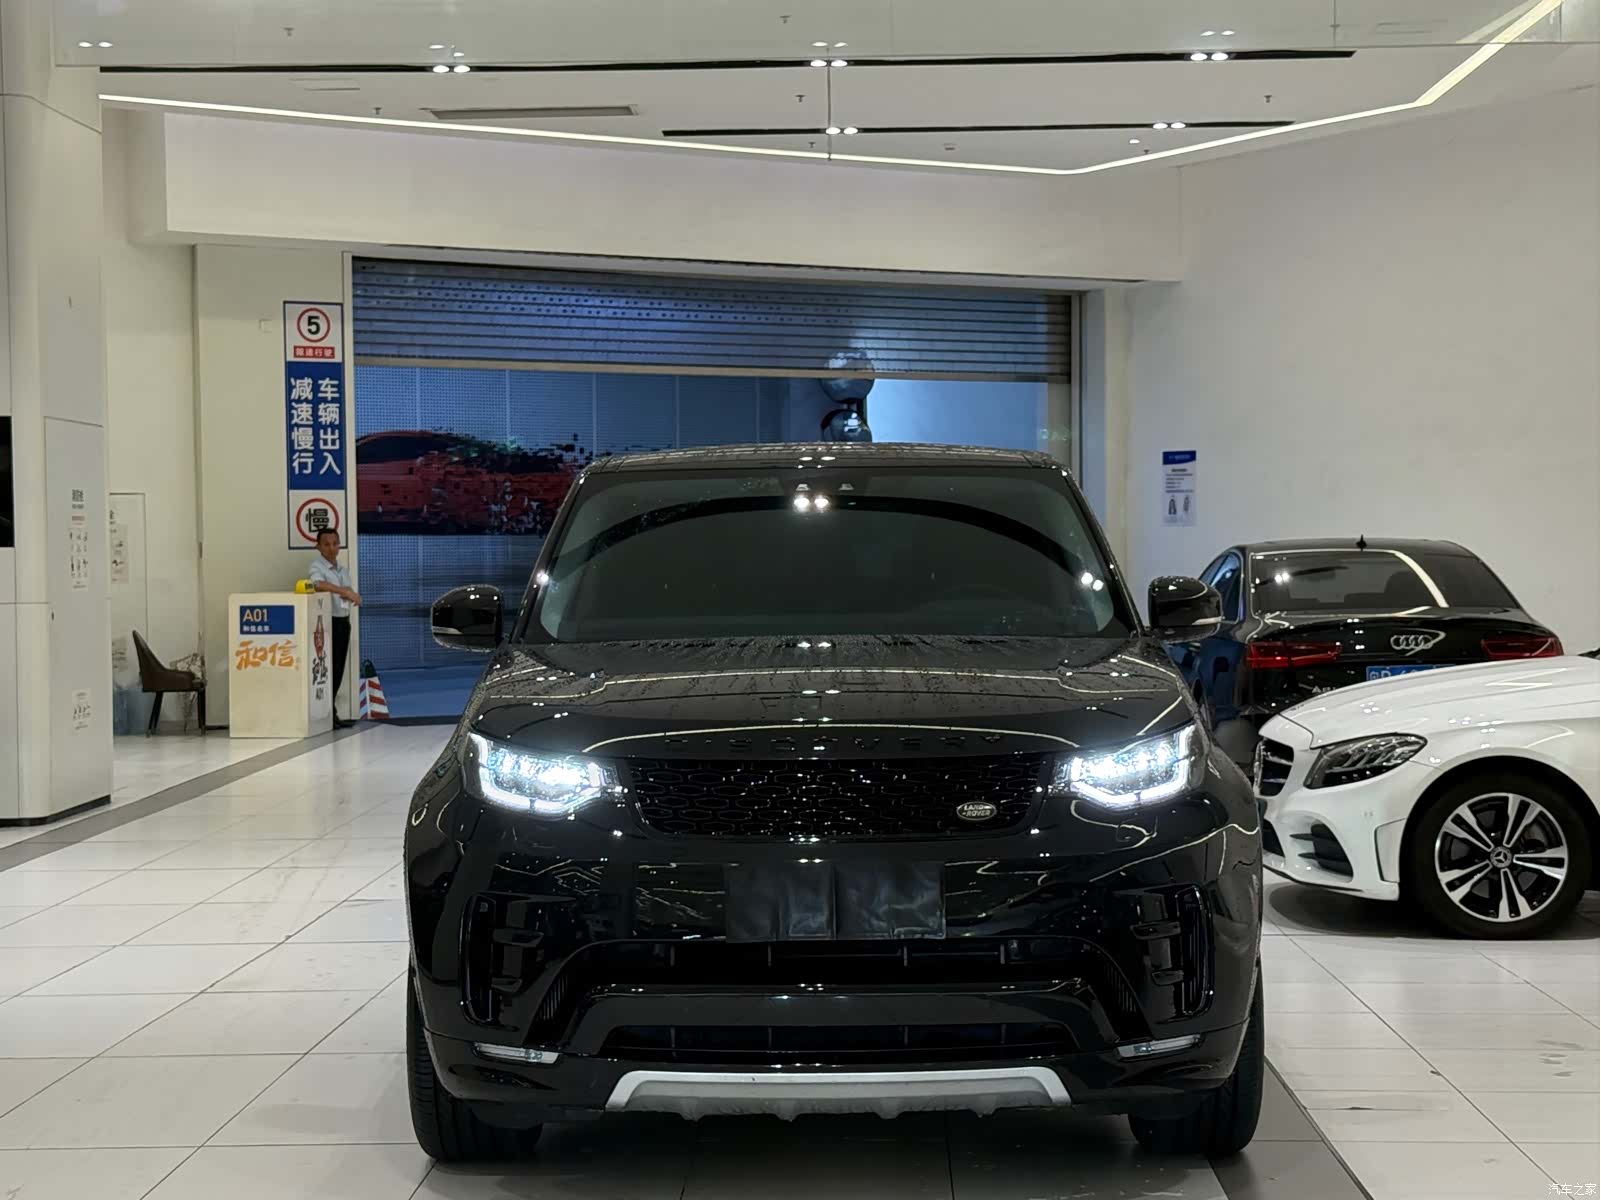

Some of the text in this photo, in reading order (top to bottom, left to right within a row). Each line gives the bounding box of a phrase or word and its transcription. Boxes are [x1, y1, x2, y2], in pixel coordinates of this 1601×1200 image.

[307, 315, 321, 335] 5
[290, 377, 314, 475] 减速慢行
[318, 377, 341, 475] 车辆出入
[305, 507, 330, 533] 慢
[242, 608, 268, 622] A01
[235, 640, 297, 670] 和信
